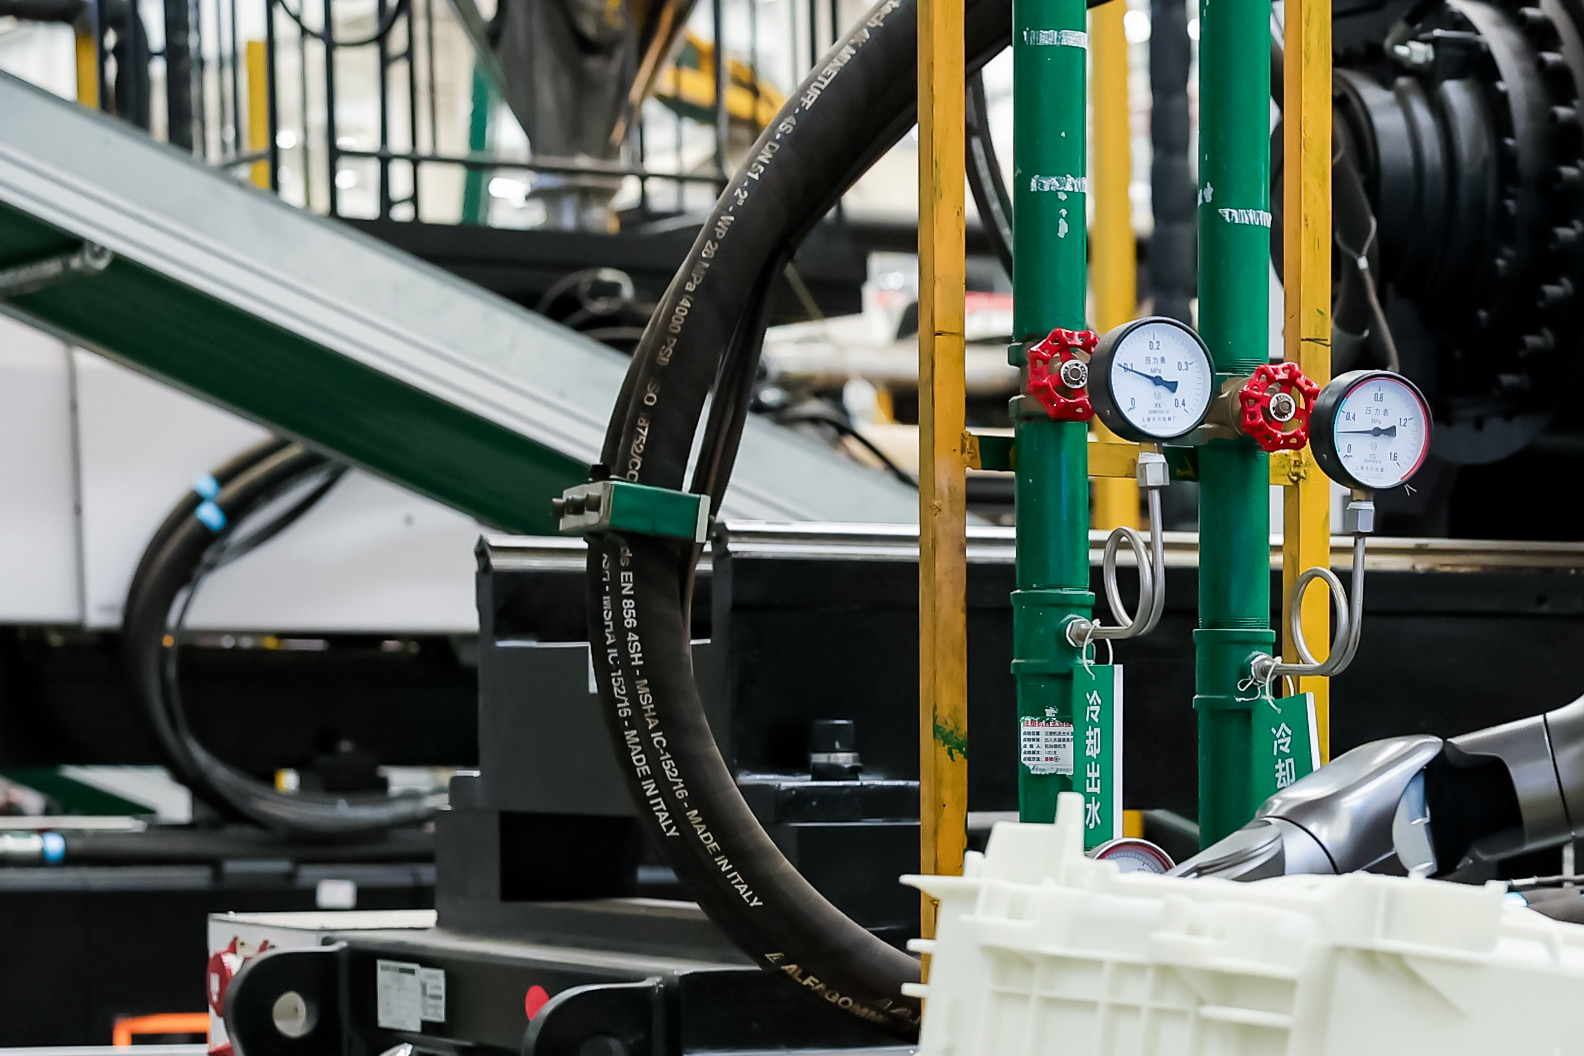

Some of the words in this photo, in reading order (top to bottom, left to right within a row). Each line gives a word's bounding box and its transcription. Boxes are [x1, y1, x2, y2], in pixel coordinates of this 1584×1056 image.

[714, 214, 735, 240] WP
[1149, 341, 1160, 351] 0.2
[1123, 363, 1134, 373] 0.1
[1145, 356, 1166, 365] 压力表
[1177, 361, 1189, 371] 0.3
[1174, 398, 1186, 408] 0.4
[1374, 393, 1383, 402] 0.8
[1345, 412, 1356, 421] 0.4
[1365, 406, 1389, 416] 压力表
[1399, 417, 1408, 427] 1.2
[1347, 444, 1352, 453] 0
[1389, 452, 1398, 461] 1.6
[620, 570, 635, 595] EN
[621, 598, 638, 629] 856
[626, 631, 644, 666] 4SH
[635, 678, 660, 730] MSHA
[624, 729, 651, 779] MADE
[1085, 689, 1102, 830] 冷却出水
[1271, 722, 1296, 789] 冷却
[641, 778, 660, 797] IN
[649, 796, 680, 837] ITALY
[686, 808, 721, 855] MADE
[714, 855, 733, 872] IN
[726, 871, 763, 907] ITALY
